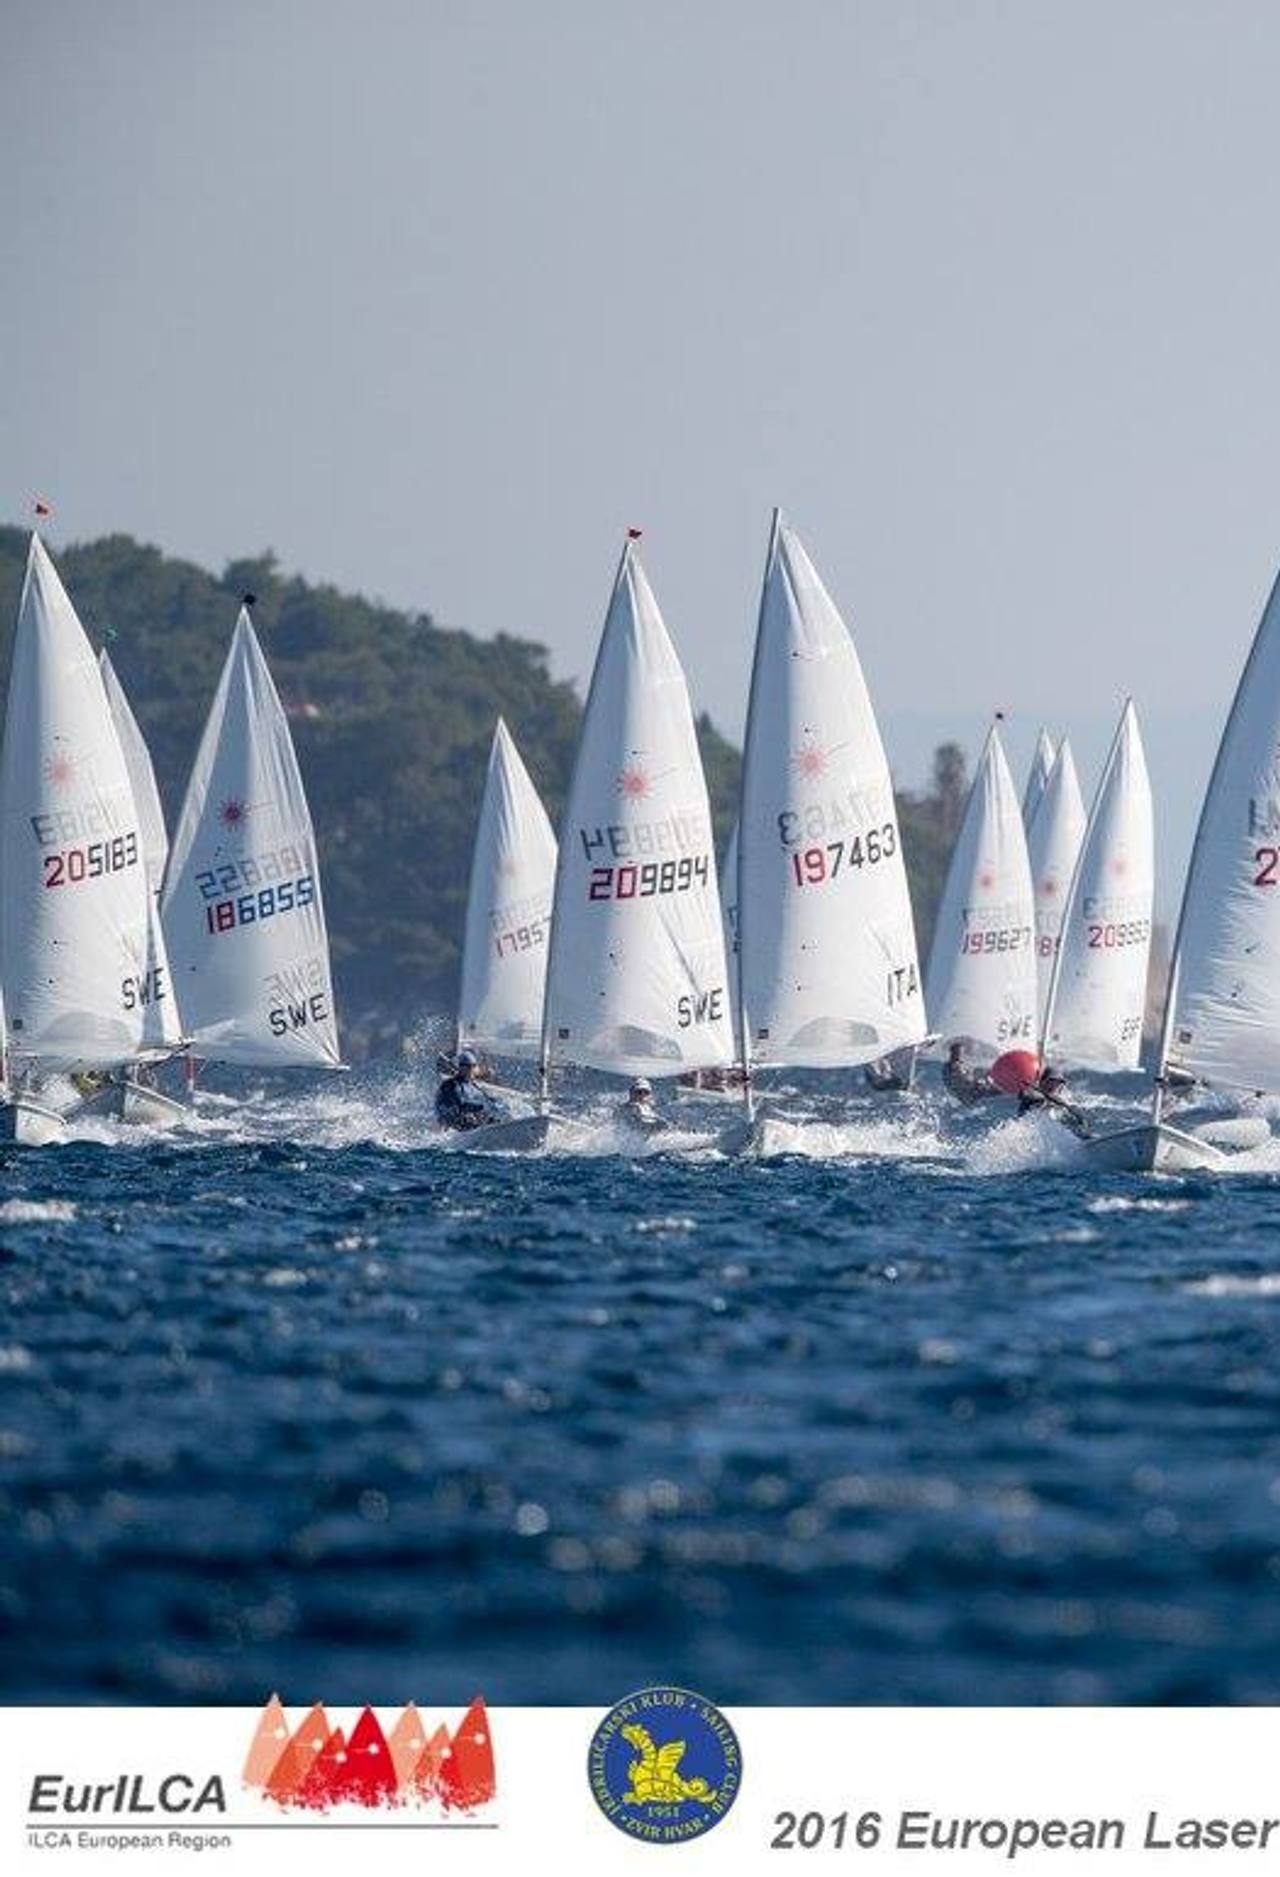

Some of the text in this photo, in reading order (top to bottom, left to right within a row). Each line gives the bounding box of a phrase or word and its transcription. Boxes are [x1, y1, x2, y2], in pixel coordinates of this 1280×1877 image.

[43, 832, 138, 888] 205183
[793, 823, 897, 886] 197463
[589, 855, 708, 900] 209894
[207, 876, 313, 935] 186855
[122, 968, 165, 1010] SWE
[888, 963, 918, 1007] ITA
[269, 993, 328, 1037] SWE
[678, 988, 723, 1028] SWE
